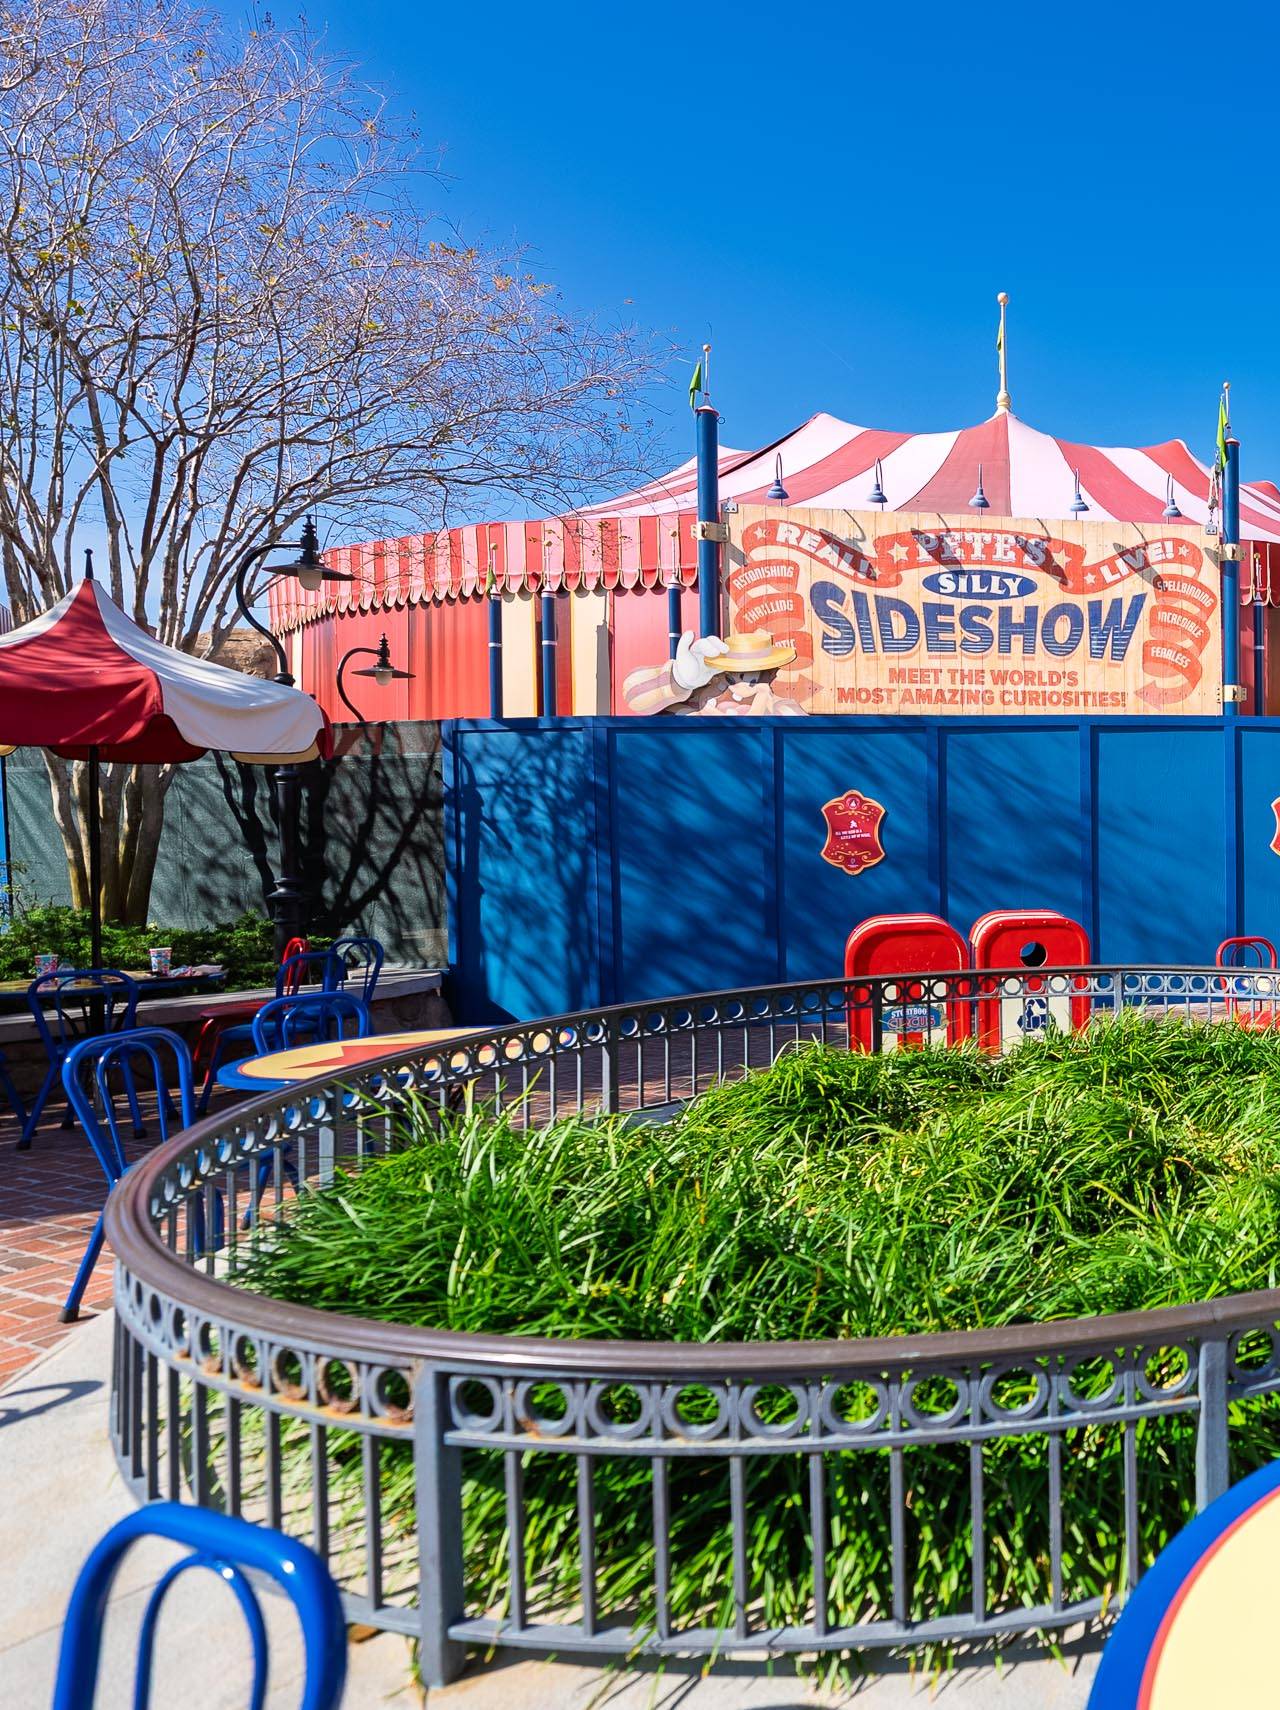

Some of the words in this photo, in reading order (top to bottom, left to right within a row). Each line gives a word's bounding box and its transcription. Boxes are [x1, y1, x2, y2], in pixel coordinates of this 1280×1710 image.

[776, 522, 872, 579] REAL!
[915, 531, 1048, 564] PETE'S
[1100, 540, 1175, 584] LIVE!
[732, 566, 795, 591] ASTONISHING
[937, 573, 1022, 597] SILLY
[1157, 580, 1214, 608] SPELLBINDING
[743, 599, 794, 624] THRILLING
[809, 580, 1148, 661] SIDESHOW
[1157, 611, 1204, 639] INCREDIBLE
[1150, 646, 1191, 669] FEARLESS
[888, 667, 943, 685] MEET
[949, 668, 986, 686] THE
[991, 668, 1079, 687] WORLD'S
[836, 687, 900, 705] MOST
[901, 688, 995, 706] AMAZING
[999, 688, 1128, 708] CURIOSITIES!
